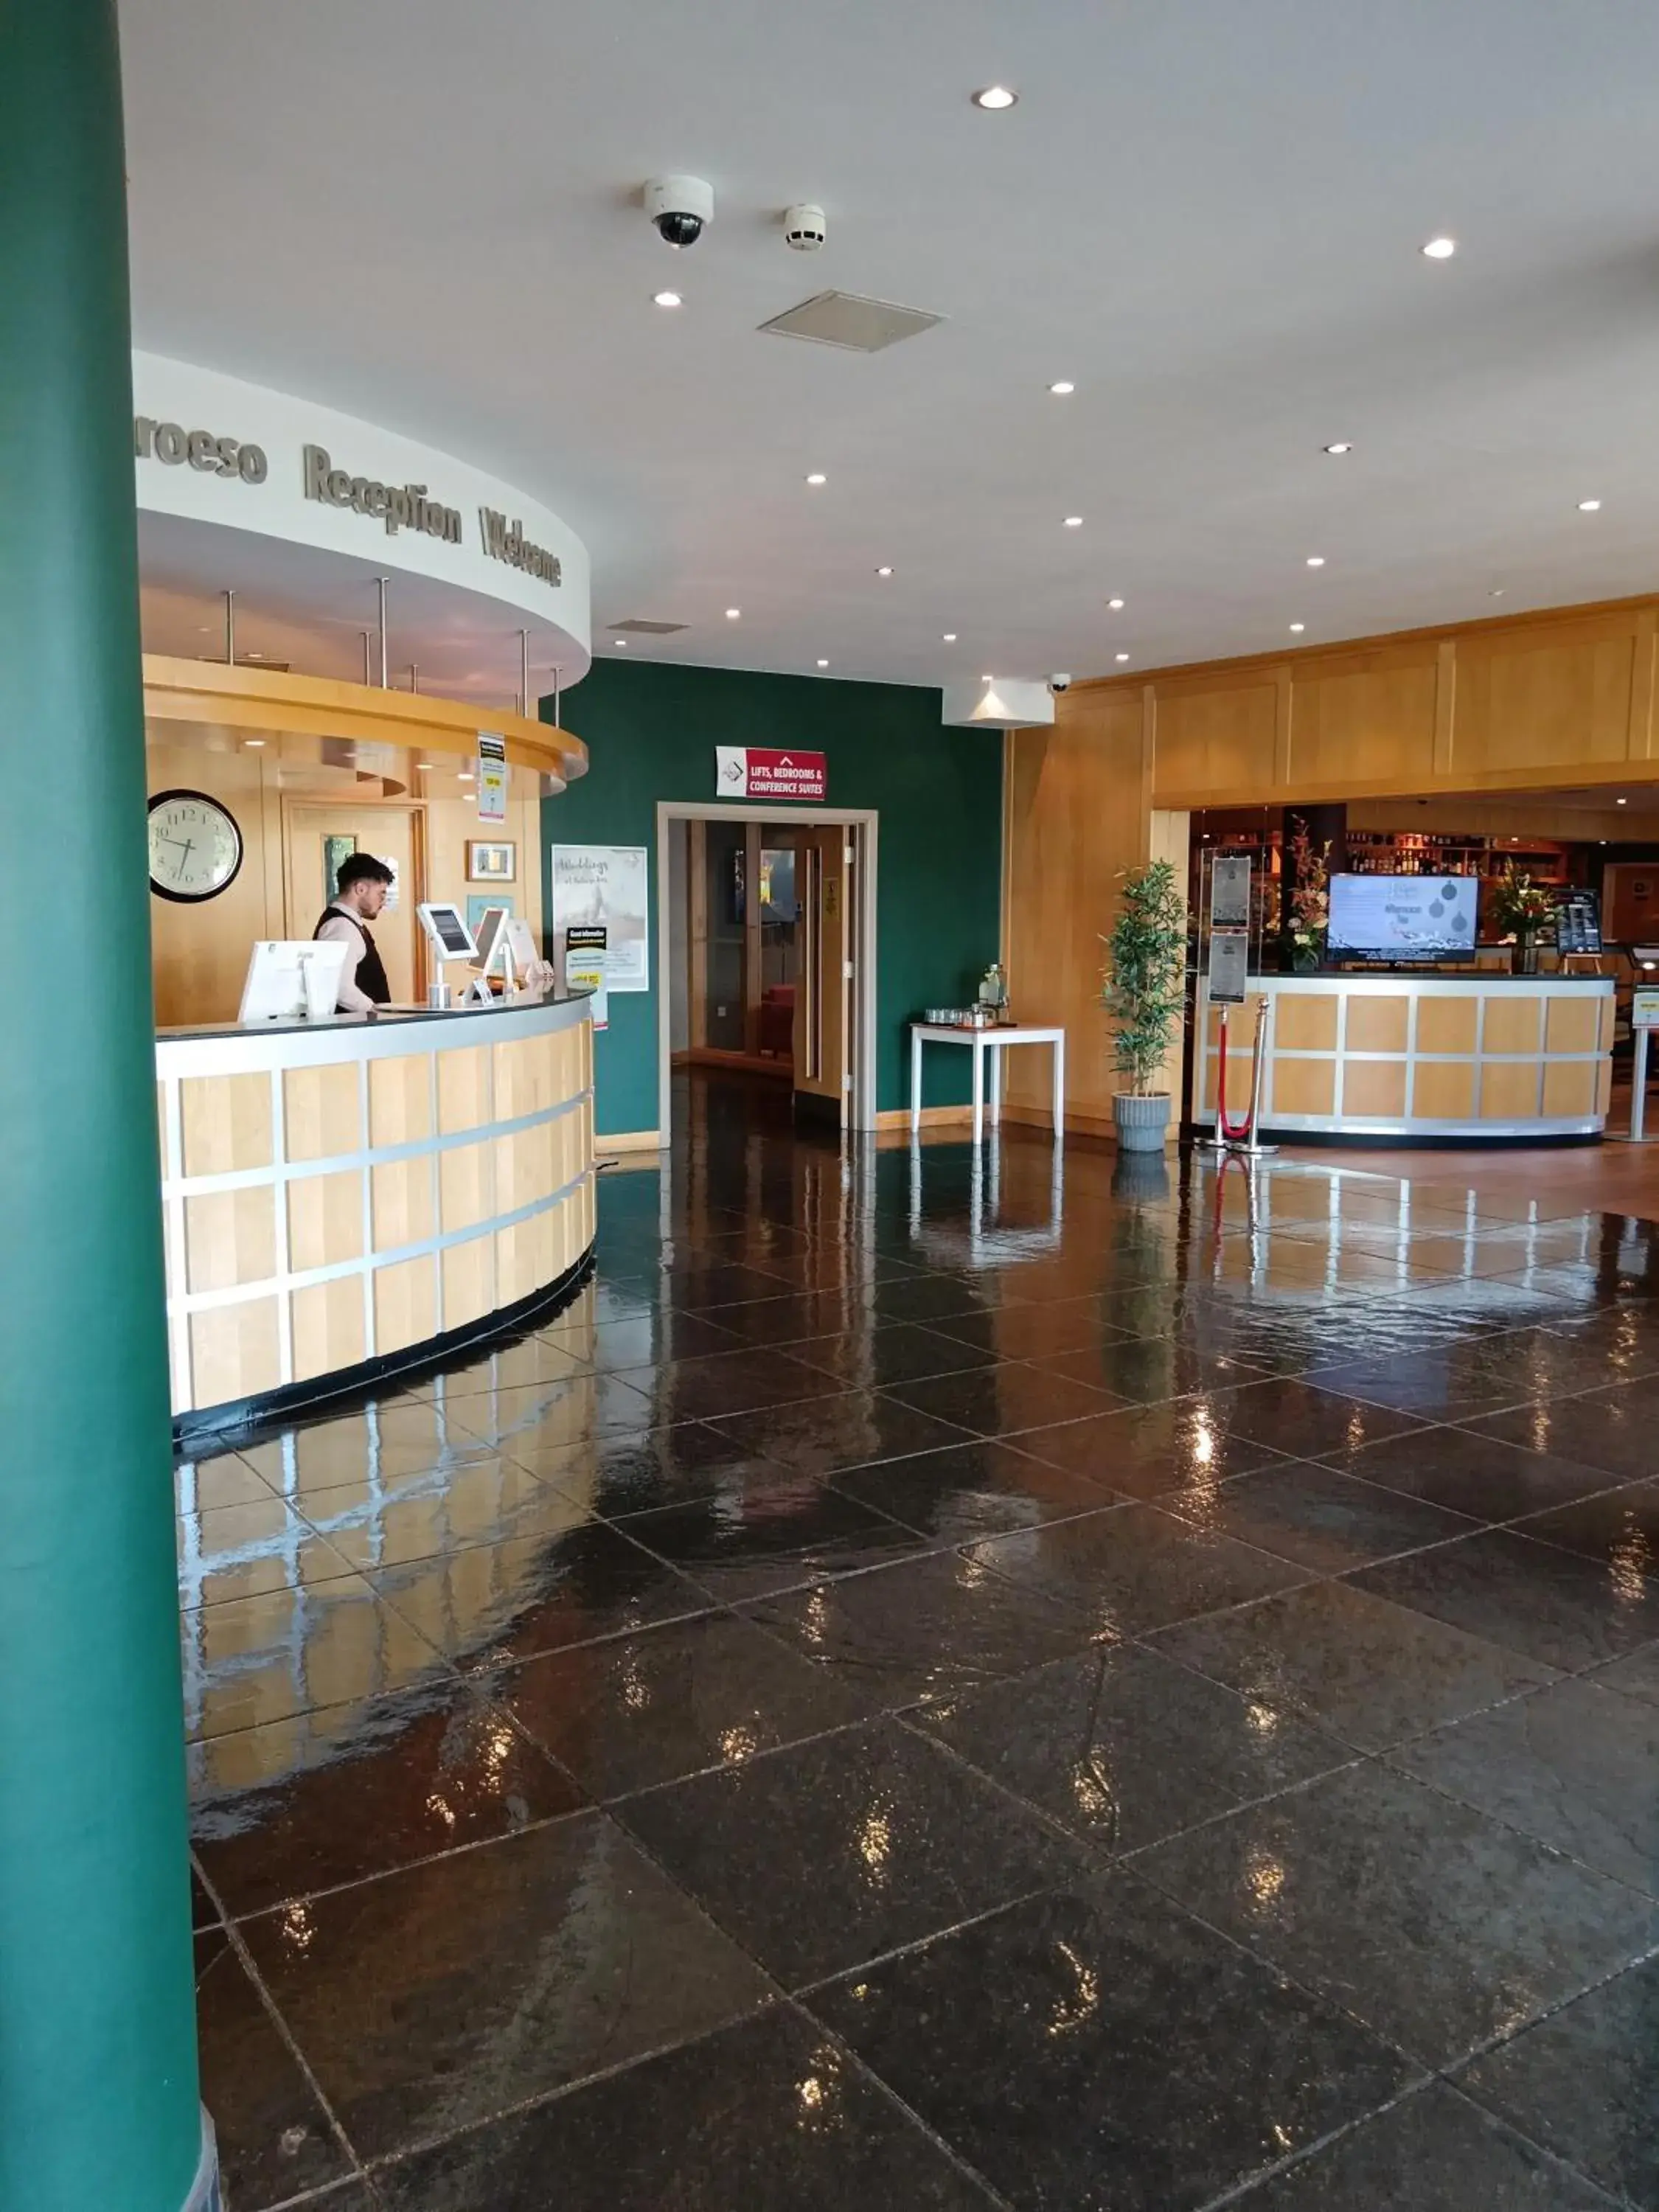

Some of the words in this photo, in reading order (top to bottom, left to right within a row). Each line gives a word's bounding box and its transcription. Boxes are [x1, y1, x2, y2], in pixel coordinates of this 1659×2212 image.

[136, 416, 268, 485] roeso
[303, 444, 462, 544] Reception
[478, 506, 561, 587] Welcome
[751, 767, 772, 779] LIFTS,
[773, 768, 815, 779] BEDROOMS
[816, 770, 822, 779] &
[750, 781, 797, 793] CONFERENCE
[799, 783, 823, 794] SUITES
[182, 809, 196, 821] 12
